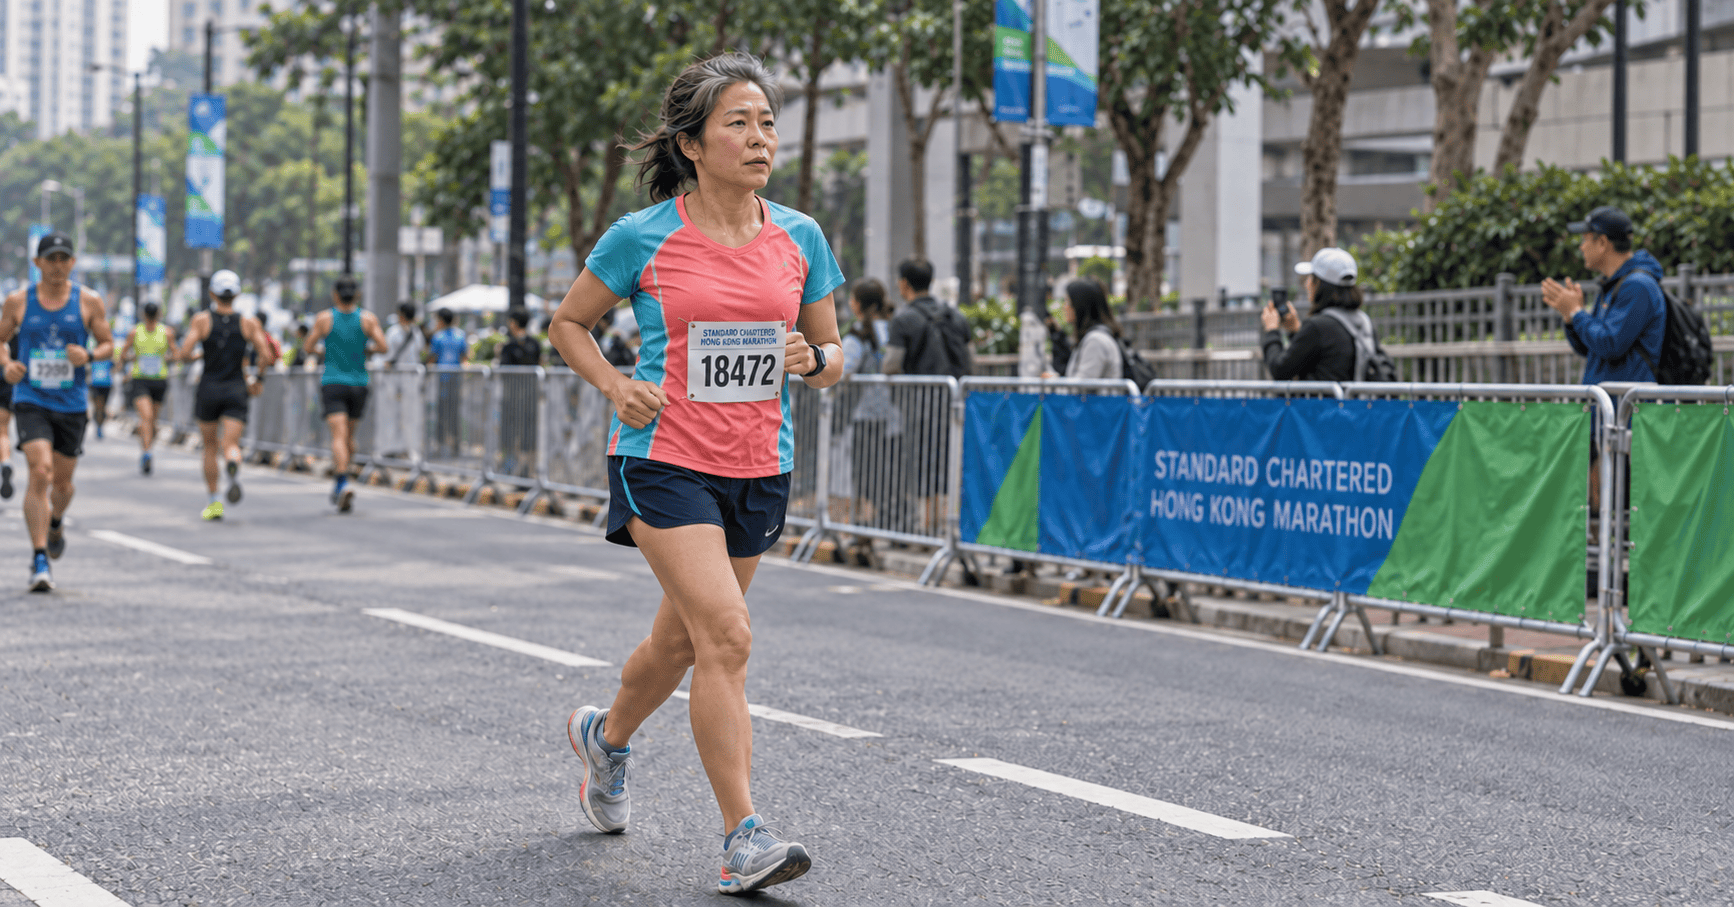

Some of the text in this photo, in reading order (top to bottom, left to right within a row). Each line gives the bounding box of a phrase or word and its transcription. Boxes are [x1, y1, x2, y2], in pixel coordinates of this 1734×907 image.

[700, 338, 721, 346] HONG
[701, 354, 776, 387] 18472
[1154, 449, 1393, 495] STANDARD CHARTERED
[1150, 488, 1393, 540] HONG KONG MARATHON
